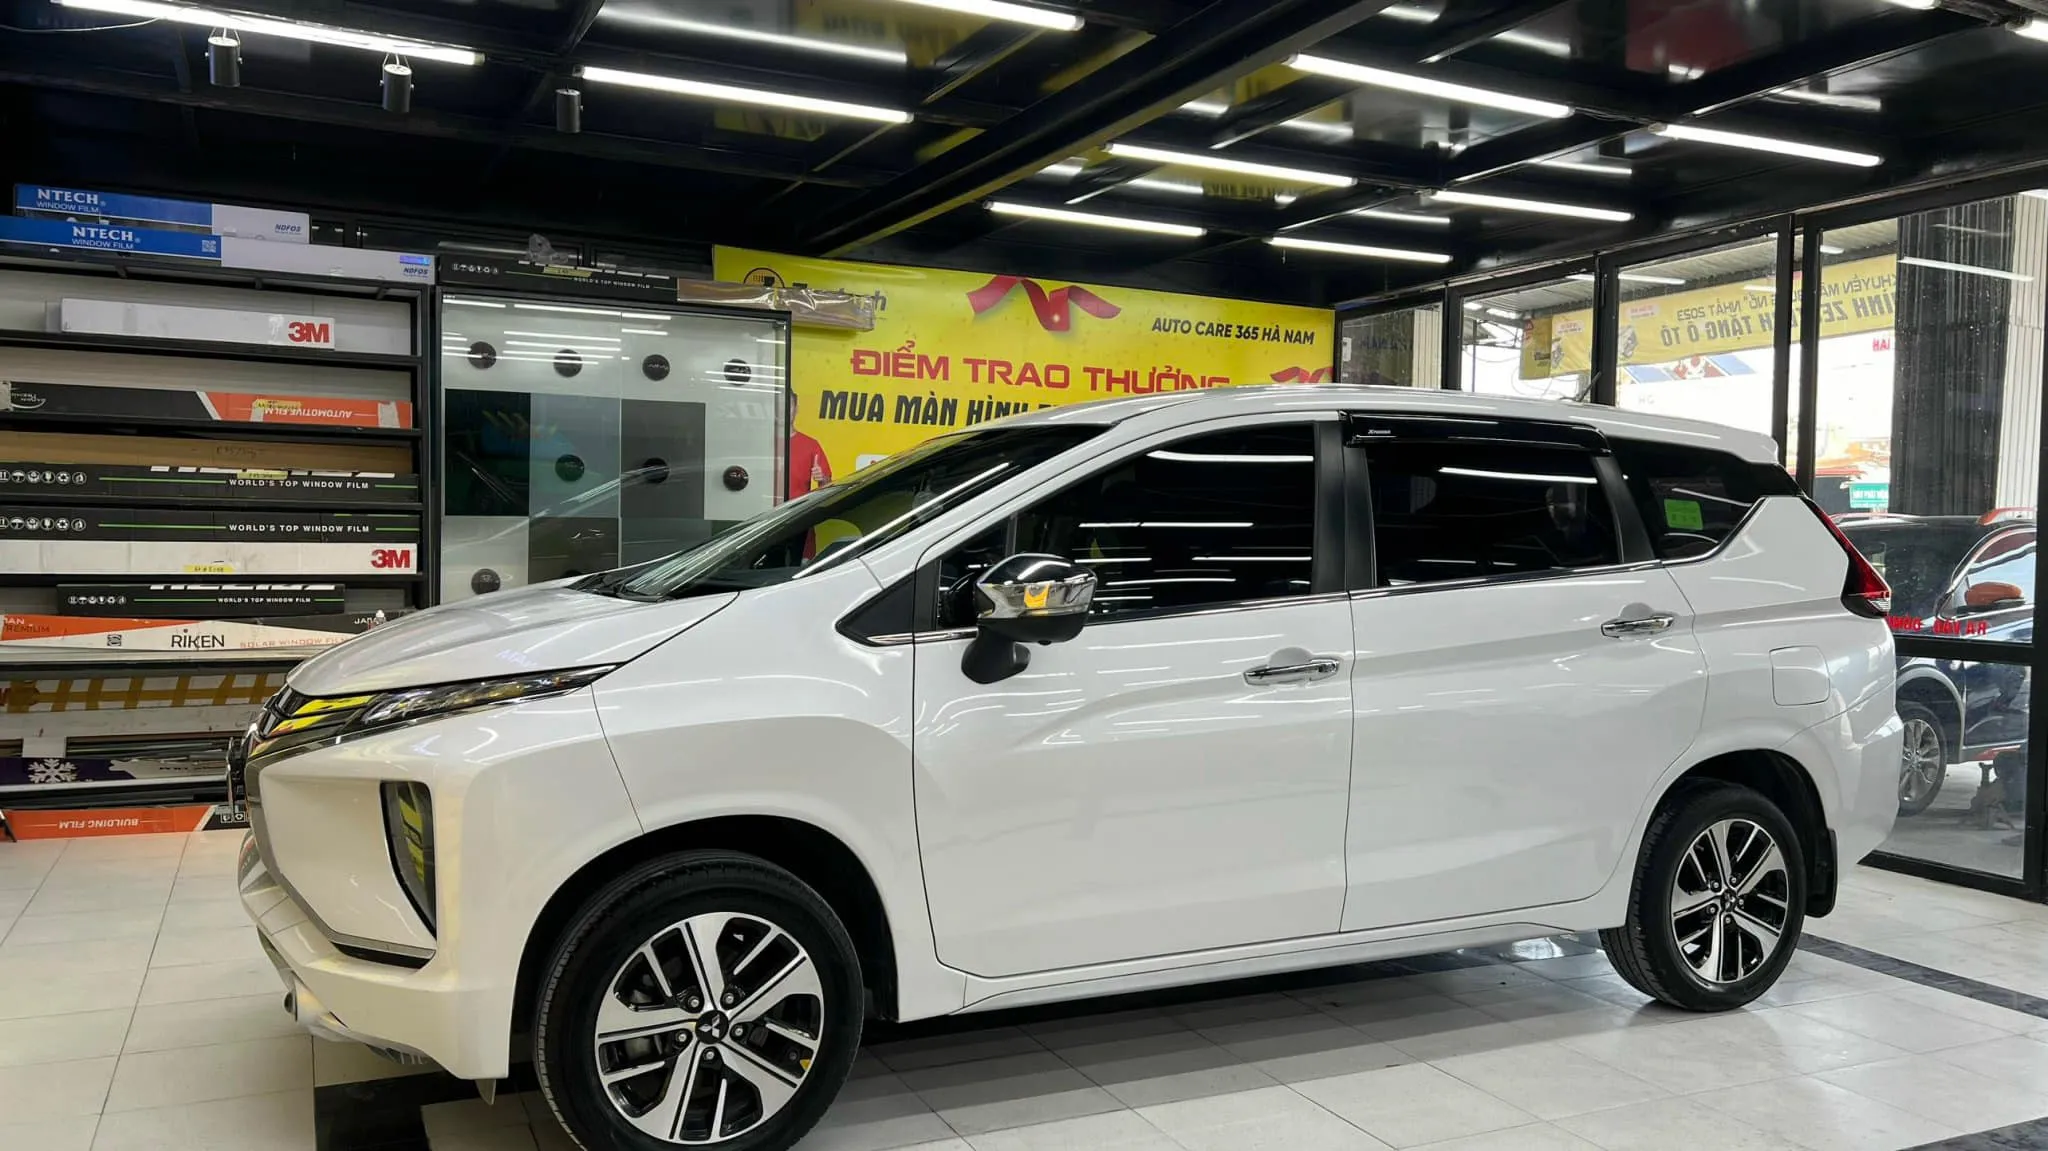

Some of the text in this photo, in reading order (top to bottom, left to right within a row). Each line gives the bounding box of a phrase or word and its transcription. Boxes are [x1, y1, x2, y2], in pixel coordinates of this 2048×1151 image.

[36, 200, 100, 213] WINDOW FILM
[71, 238, 134, 250] WINDOW FILM
[288, 321, 330, 344] 3M
[1152, 317, 1314, 345] AUTO CARE 365 HÀ NAM
[850, 340, 949, 381] ĐIỂM
[963, 358, 1070, 389] TRAO
[264, 407, 353, 418] AUTOMOTIVE FILM
[819, 390, 884, 422] MUA
[894, 391, 959, 426] MÀN
[229, 479, 275, 488] WORLD'S
[302, 481, 342, 489] WINDOW
[229, 524, 276, 532] WORLD'S
[303, 525, 343, 533] WINDOW
[370, 549, 411, 569] 3M
[171, 634, 225, 648] RIKEN
[240, 641, 275, 649] SOLAR
[279, 638, 323, 646] WINDOW
[59, 818, 139, 829] BUILDING FILM
